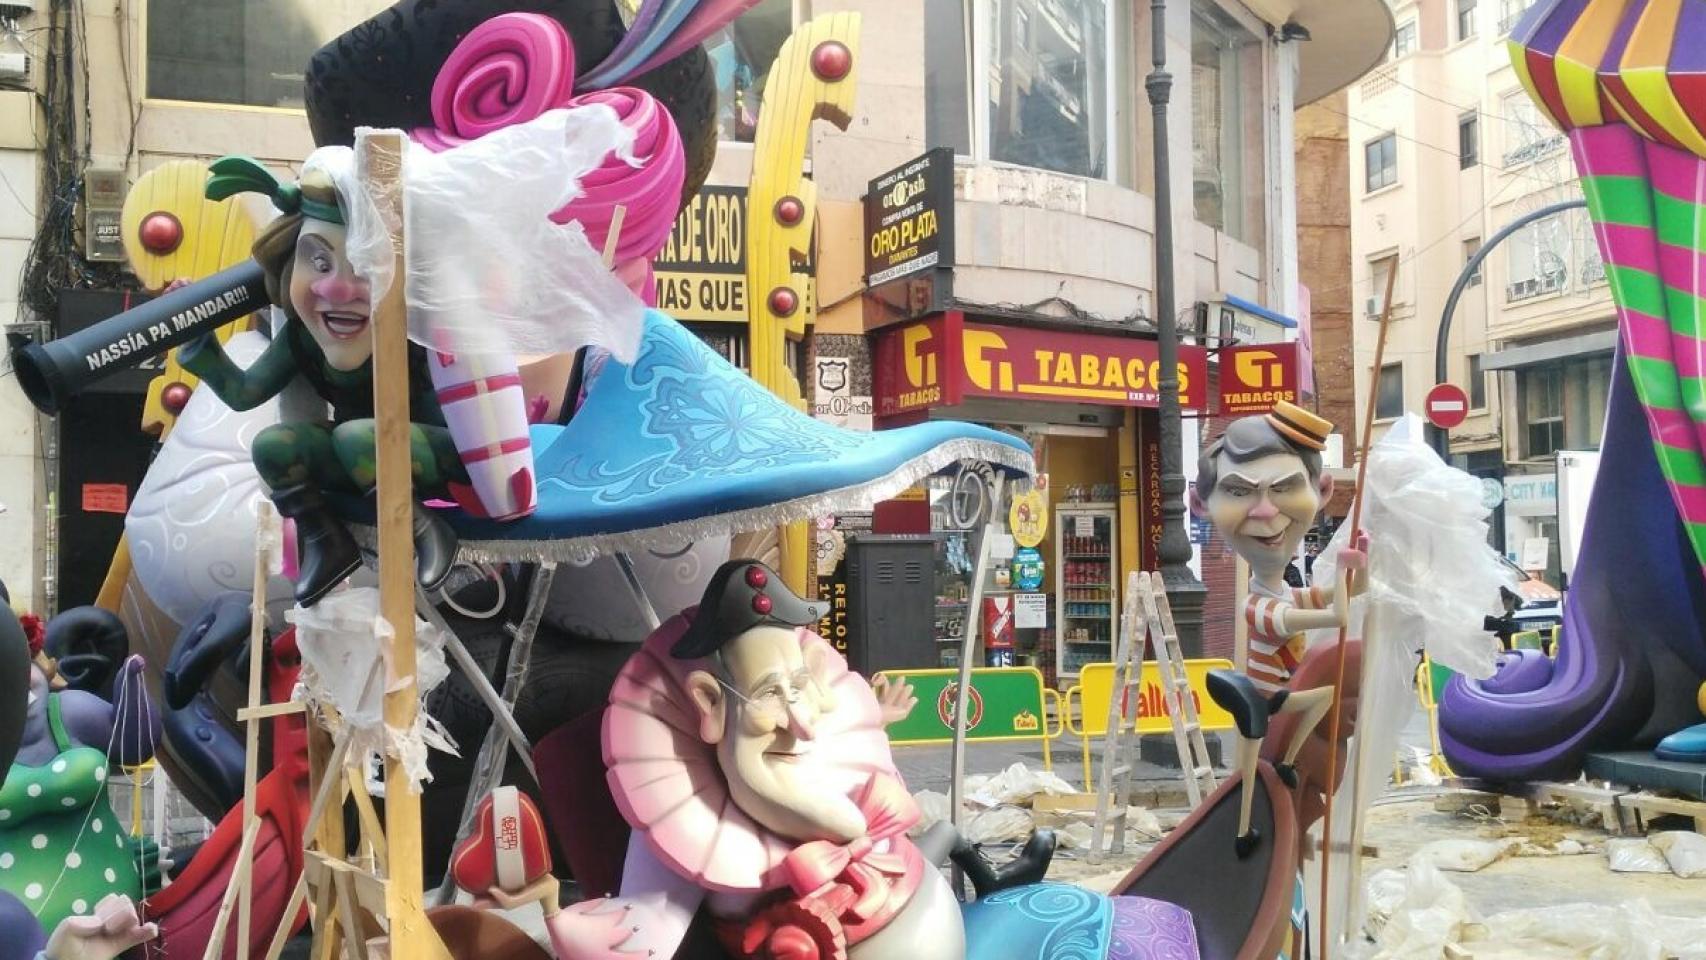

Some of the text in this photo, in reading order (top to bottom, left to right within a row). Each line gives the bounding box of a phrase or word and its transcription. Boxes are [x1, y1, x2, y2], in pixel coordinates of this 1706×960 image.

[680, 193, 702, 263] DE
[706, 194, 742, 265] ORO
[871, 208, 938, 258] ORO PLATA
[147, 321, 172, 342] PA
[171, 285, 250, 332] MANDAR!!!
[699, 278, 744, 312] QUE
[900, 386, 941, 408] TABACOS
[1223, 390, 1295, 405] TABACOS
[1149, 443, 1161, 518] RECARGAS
